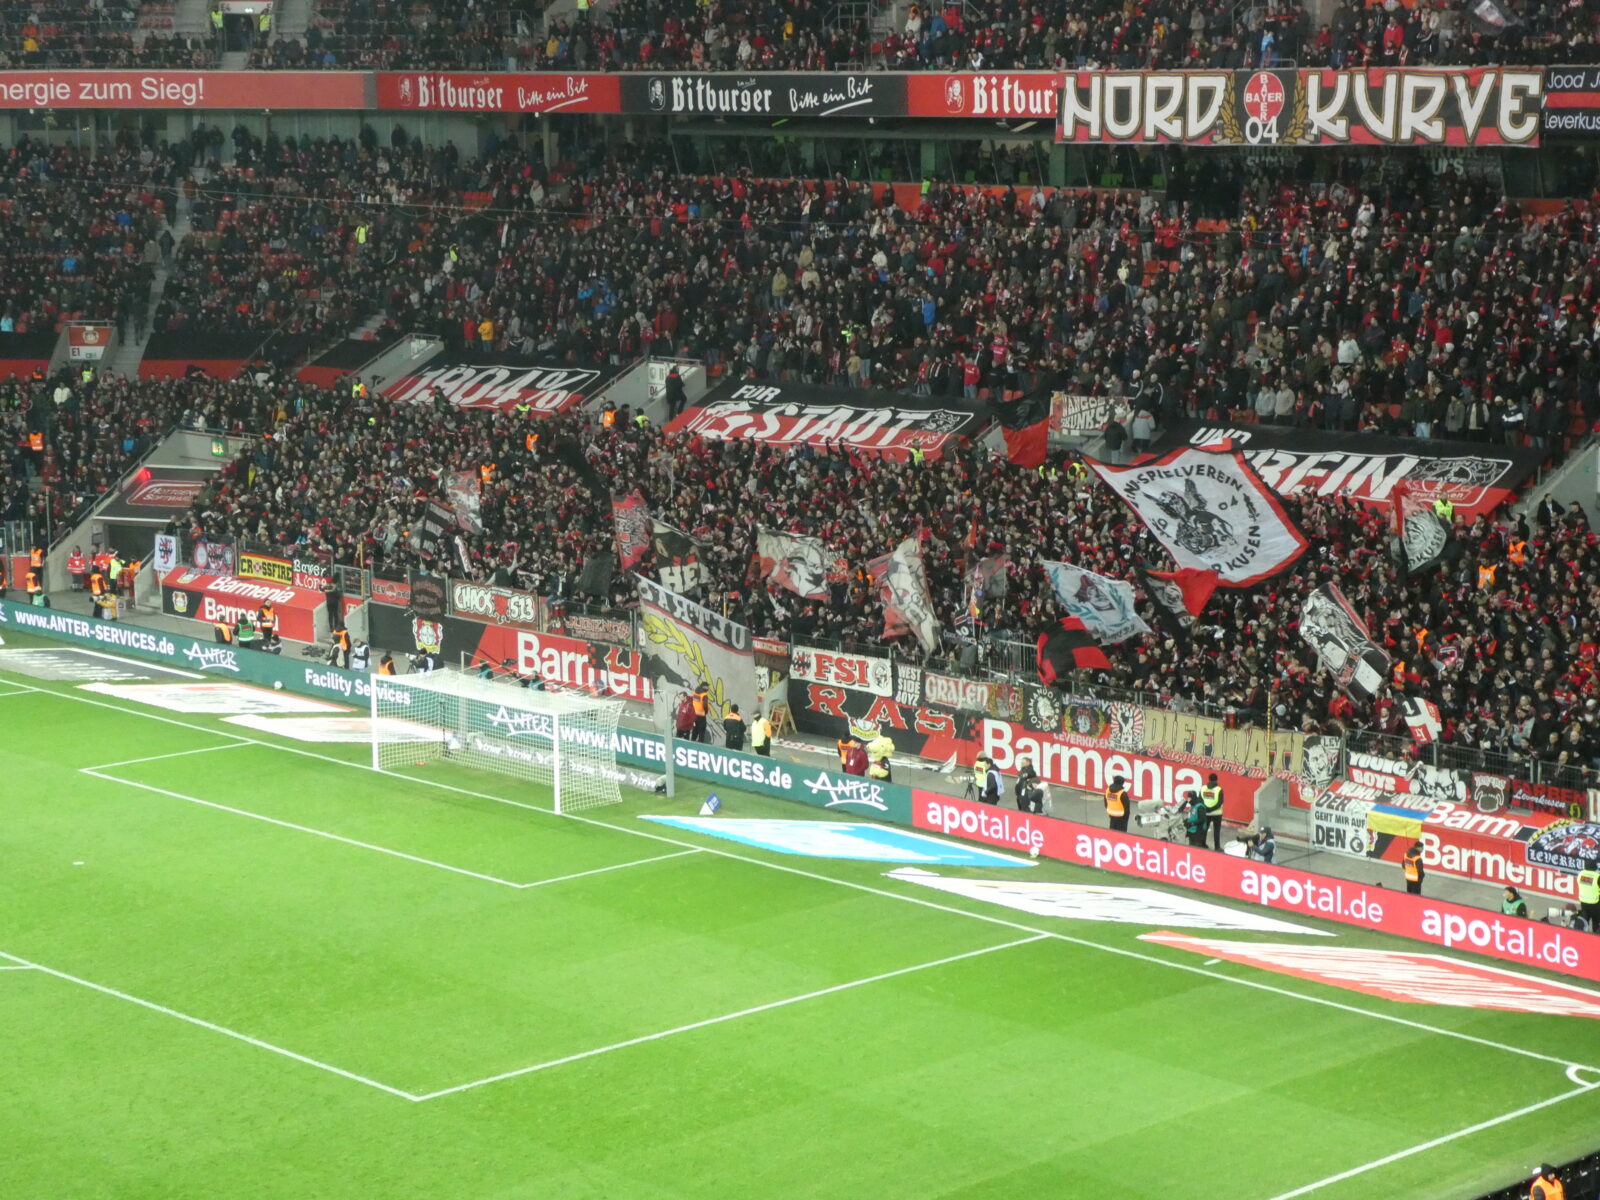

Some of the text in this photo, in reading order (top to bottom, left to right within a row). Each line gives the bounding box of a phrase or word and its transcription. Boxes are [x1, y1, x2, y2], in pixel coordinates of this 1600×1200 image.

[79, 82, 132, 100] zum
[141, 77, 204, 105] Sieg!
[418, 75, 503, 108] Bitburger
[518, 76, 589, 109] Bitte ein Bit
[671, 76, 773, 112] Bitburger
[789, 77, 873, 112] Bitte ein Bit
[972, 75, 1057, 115] Bitbur
[1547, 71, 1586, 89] Jood
[1062, 72, 1541, 141] NORD KURVE
[1246, 92, 1282, 102] BAYER
[1260, 74, 1268, 121] BAYER
[1246, 116, 1279, 144] 04
[730, 384, 782, 402] FÜR
[751, 402, 933, 448] STADT
[206, 575, 296, 604] Barmenia
[454, 583, 495, 616] CHAOS
[305, 668, 352, 695] Facility
[814, 652, 870, 687] FSI
[897, 665, 922, 681] WEST
[897, 678, 921, 694] SIDE
[984, 719, 1202, 804] Barmenia
[1349, 751, 1409, 777] YOUNG
[926, 801, 1044, 849] apotal.de
[1315, 811, 1366, 828] GEHT MIR AUF
[1315, 824, 1347, 849] DEN
[1075, 833, 1206, 884] apotal.de
[1420, 832, 1574, 895] Barmenia
[1240, 869, 1383, 923] apotal.de
[1420, 909, 1579, 967] apotal.de
